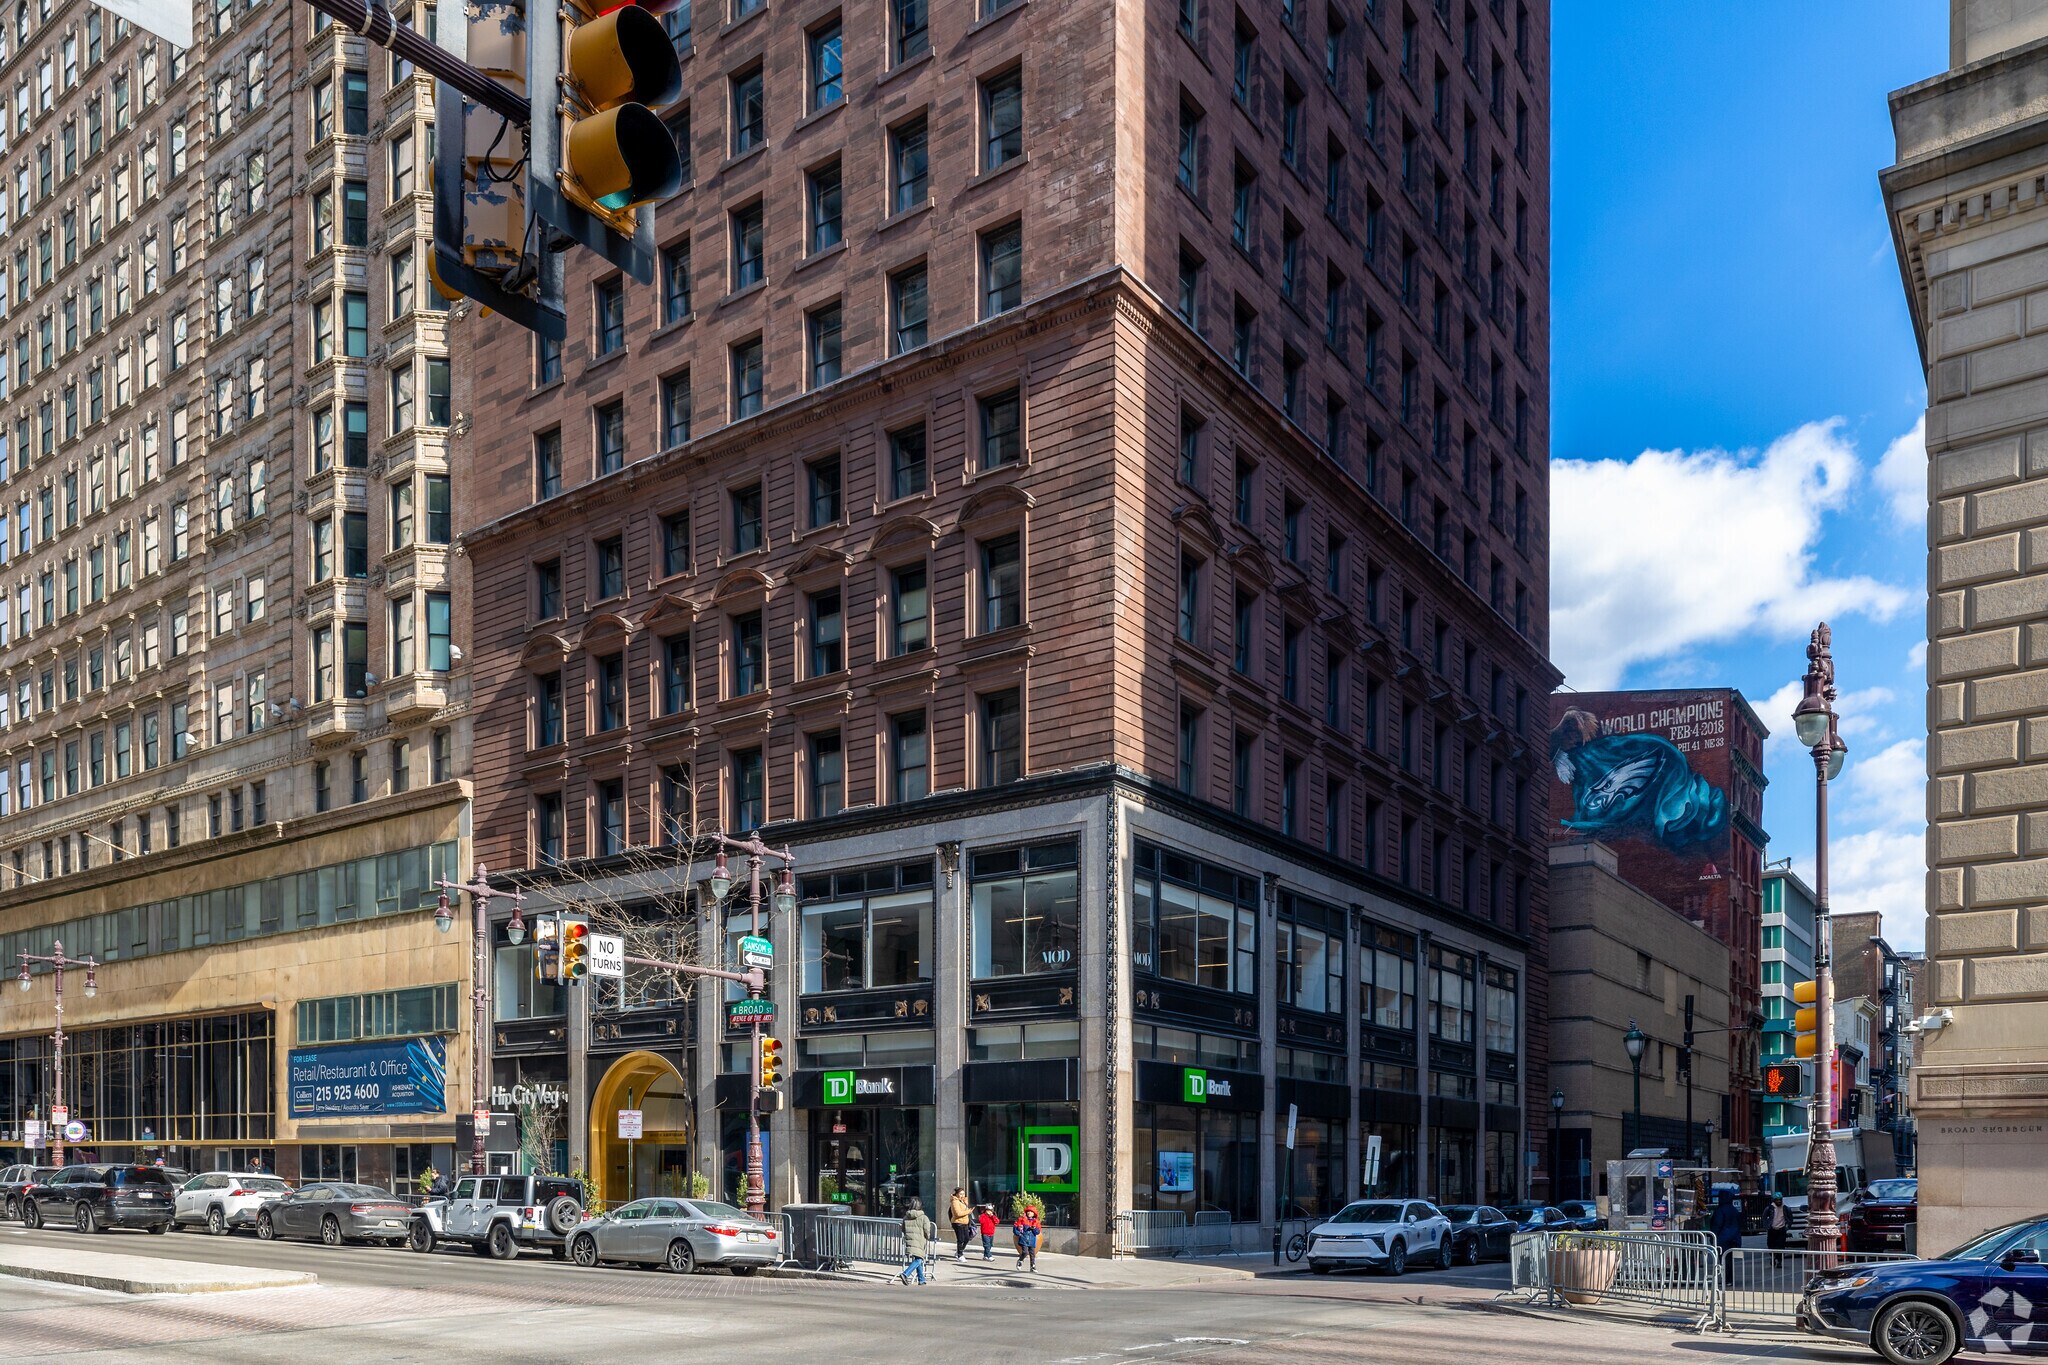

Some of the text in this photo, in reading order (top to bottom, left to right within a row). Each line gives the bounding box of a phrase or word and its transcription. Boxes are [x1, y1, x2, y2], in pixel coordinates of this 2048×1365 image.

[1600, 700, 1723, 736] WORLD CHAMPIONS
[1678, 742, 1690, 752] PHI
[1692, 742, 1700, 750] 41
[600, 940, 614, 954] NO
[744, 940, 766, 953] SANSOM
[1042, 949, 1070, 964] MOD
[592, 958, 621, 971] TURNS
[739, 1005, 763, 1014] BROAD
[293, 1060, 407, 1082] Retail/Restaurant & Office
[316, 1083, 379, 1101] 215 925 4600
[856, 1078, 894, 1094] Bank
[1206, 1079, 1231, 1096] Bank
[295, 1090, 312, 1099] Colliers
[1028, 1143, 1072, 1176] TD
